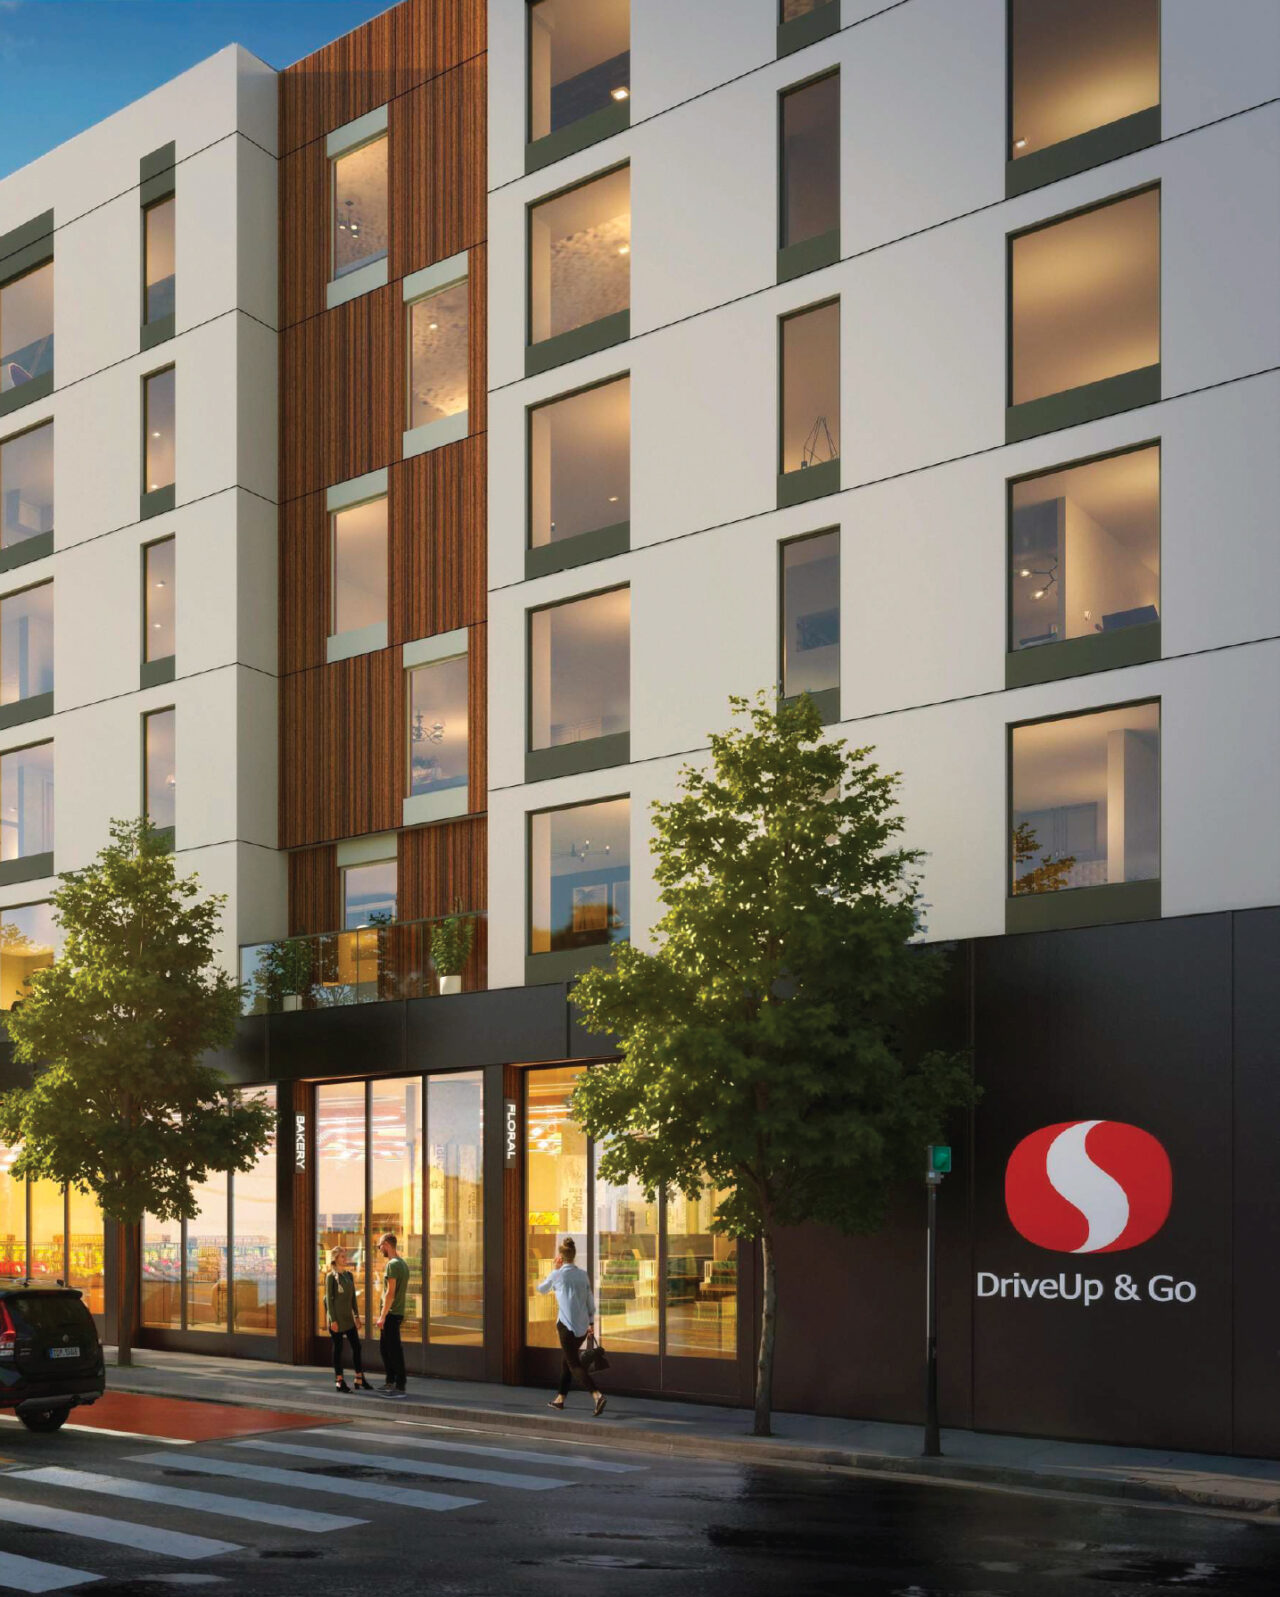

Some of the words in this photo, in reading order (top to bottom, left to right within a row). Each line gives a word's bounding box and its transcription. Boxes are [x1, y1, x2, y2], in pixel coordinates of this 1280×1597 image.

[296, 1115, 305, 1169] BAKERY
[507, 1104, 516, 1160] FLORAL
[976, 1272, 1104, 1306] DriveUp
[1114, 1274, 1142, 1301] &
[1148, 1275, 1197, 1302] Go
